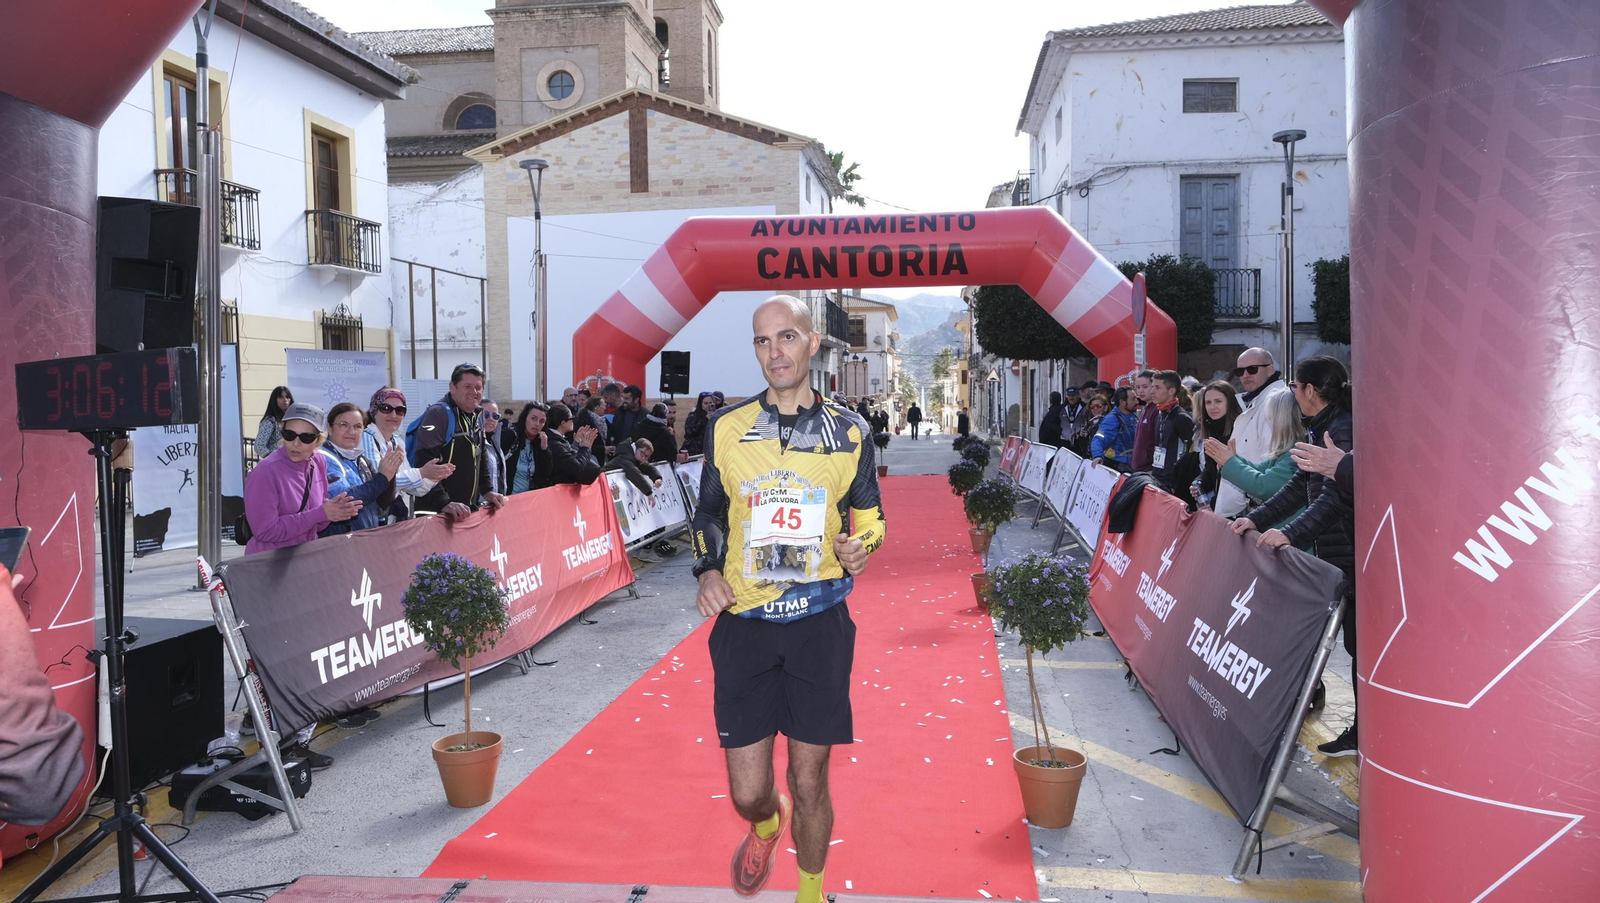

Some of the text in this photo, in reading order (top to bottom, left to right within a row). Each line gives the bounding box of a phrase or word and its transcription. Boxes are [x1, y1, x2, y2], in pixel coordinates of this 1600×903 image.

[751, 213, 976, 237] AYUNTAMIENTO
[757, 243, 968, 279] CANTORIA
[295, 357, 343, 365] CONSTRUYAMOS
[47, 356, 174, 421] 3:06:12
[157, 441, 198, 466] LIBERT
[628, 491, 679, 520] CANORIA
[771, 507, 802, 530] 45
[562, 531, 613, 570] TEAMERGY
[1101, 539, 1131, 578] TEAMERGY
[499, 563, 543, 608] MERGY
[1136, 571, 1177, 623] TEAMERGY
[764, 597, 809, 613] UTMB
[765, 608, 808, 619] MONT-BLANC
[311, 618, 432, 684] TEAMERG
[1186, 617, 1272, 699] TEAMERGY
[354, 662, 421, 702] www.teamergy.es
